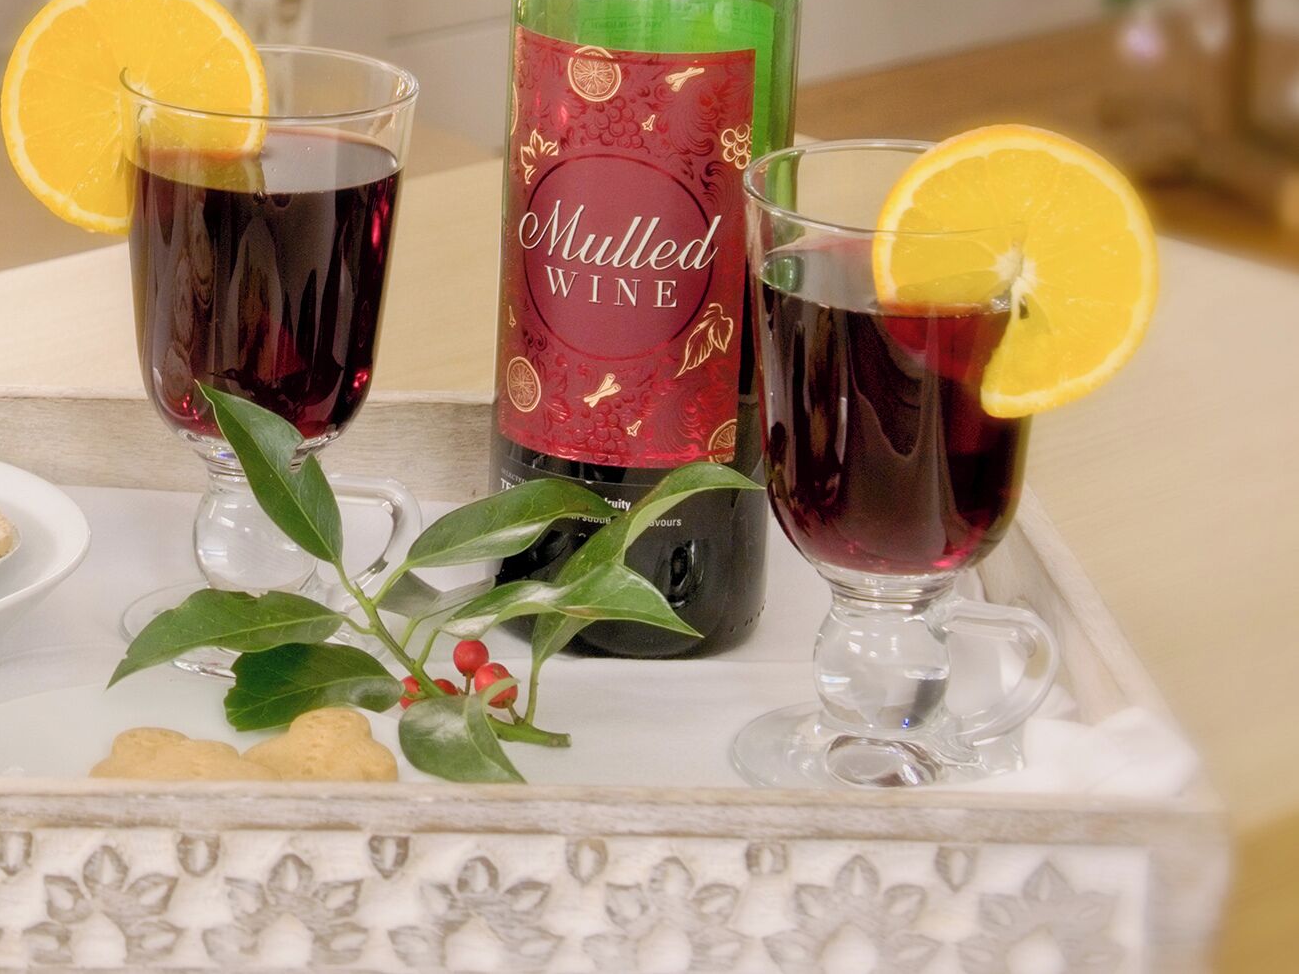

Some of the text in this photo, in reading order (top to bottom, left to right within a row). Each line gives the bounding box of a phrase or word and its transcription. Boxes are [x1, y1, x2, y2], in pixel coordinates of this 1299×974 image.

[519, 199, 722, 271] Mulled
[544, 264, 678, 308] WINE
[648, 518, 682, 528] avours
